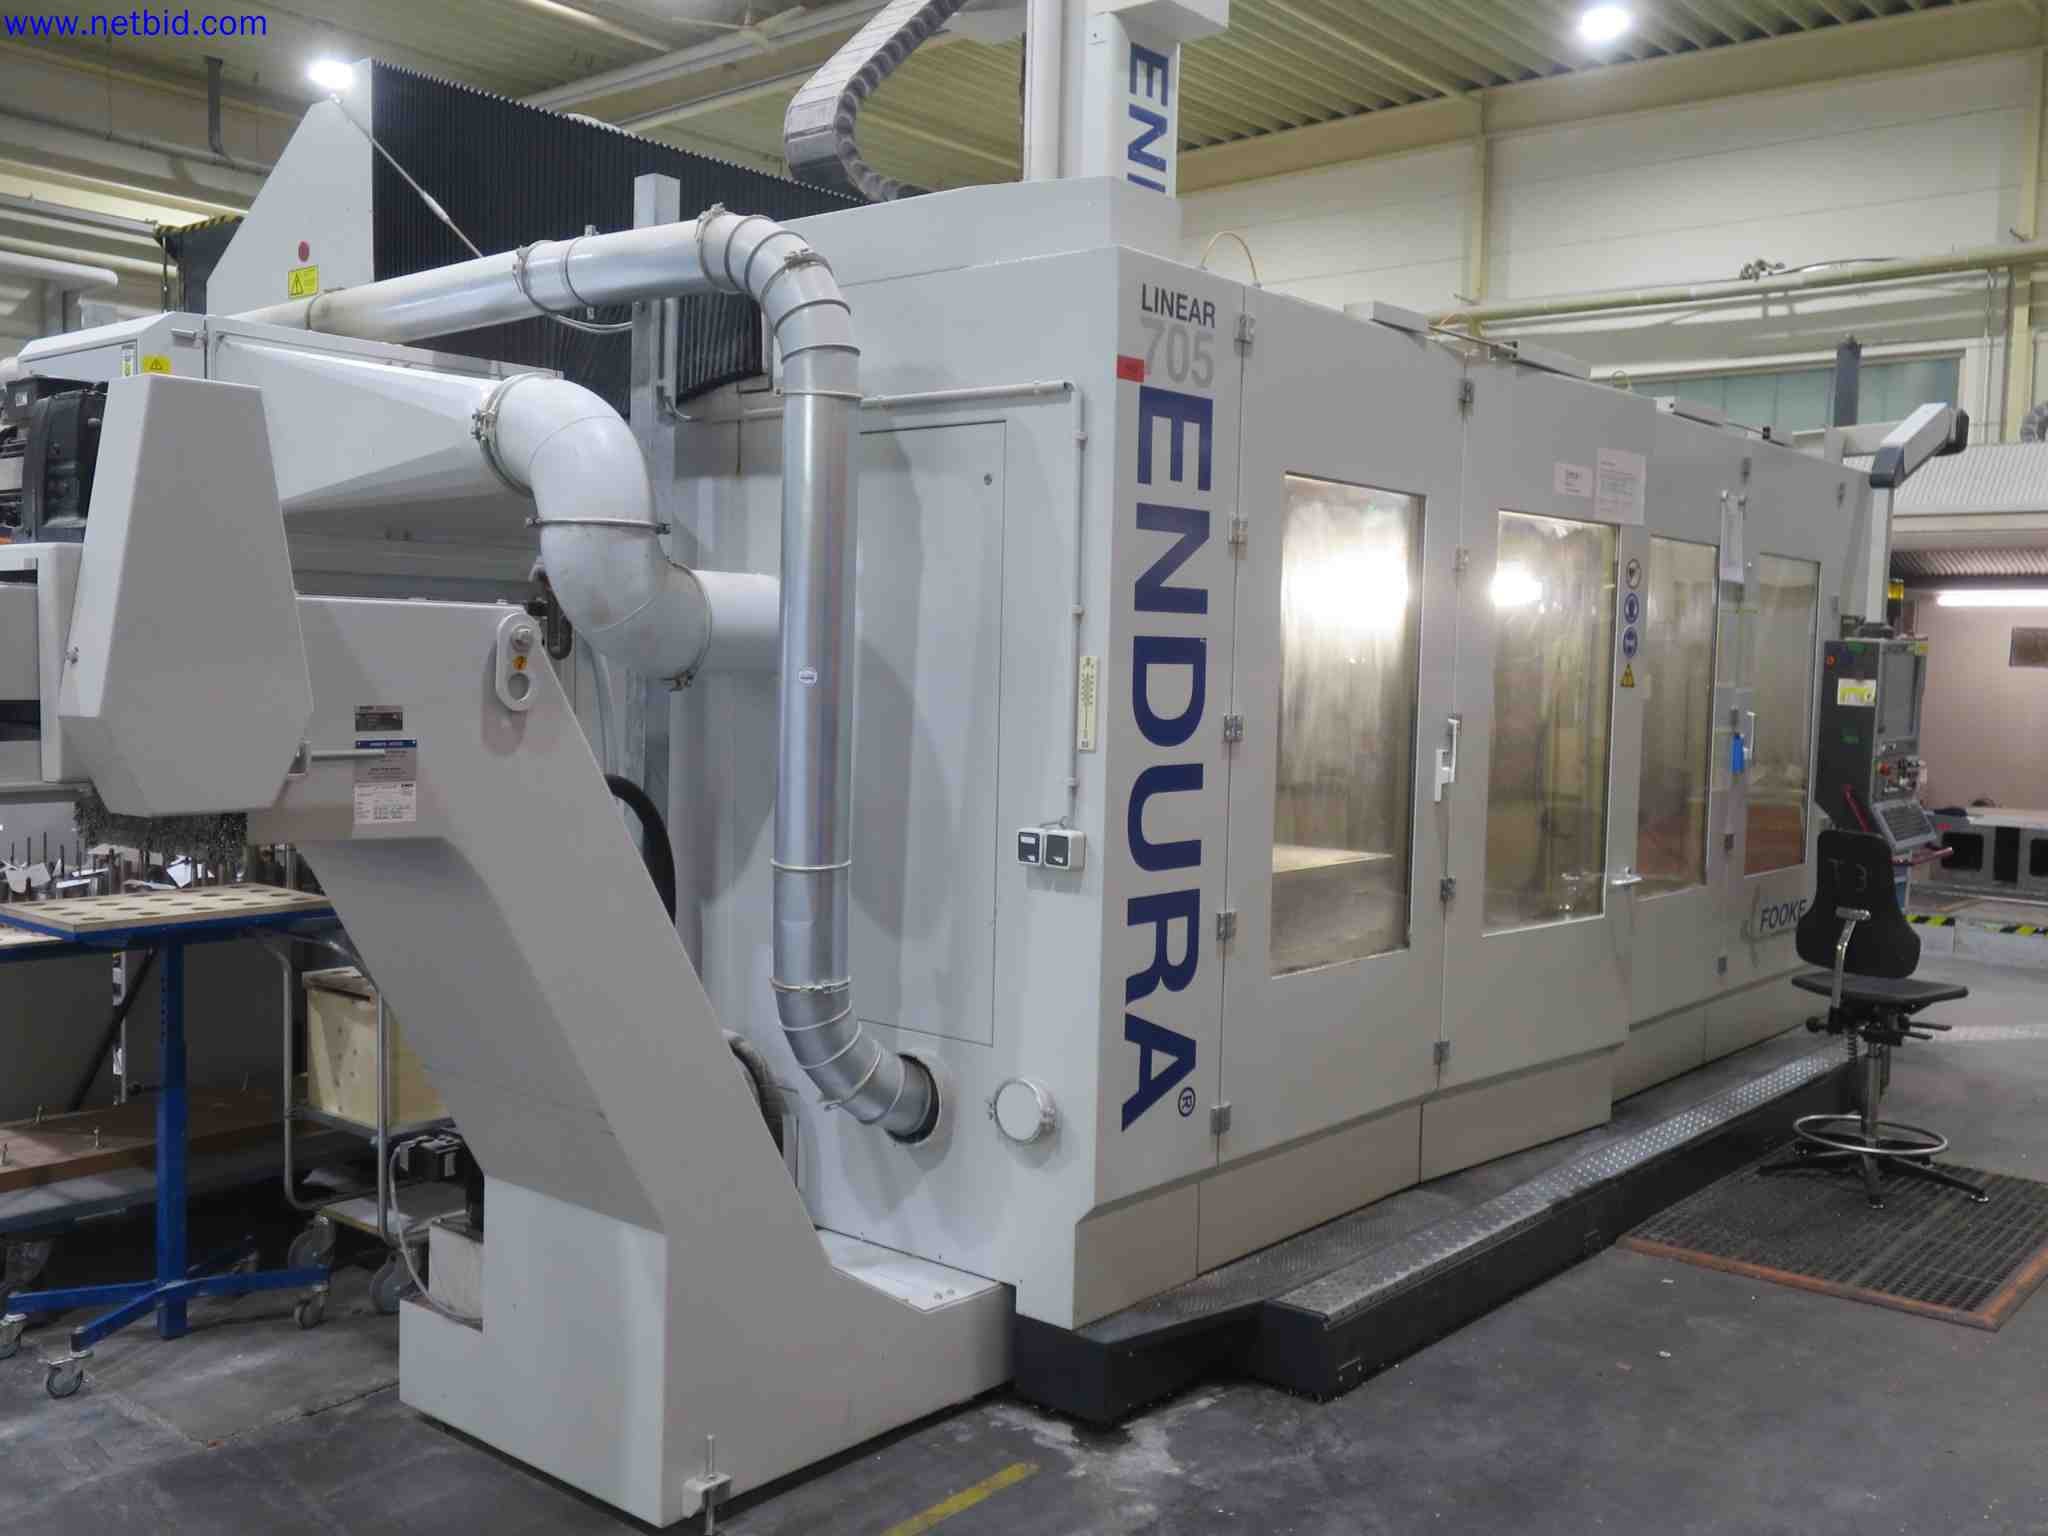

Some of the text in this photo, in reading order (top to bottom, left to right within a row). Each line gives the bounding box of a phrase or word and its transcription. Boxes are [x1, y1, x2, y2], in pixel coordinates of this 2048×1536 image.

[1127, 42, 1169, 193] EN
[1141, 283, 1216, 328] LINEAR
[1140, 317, 1215, 388] 705
